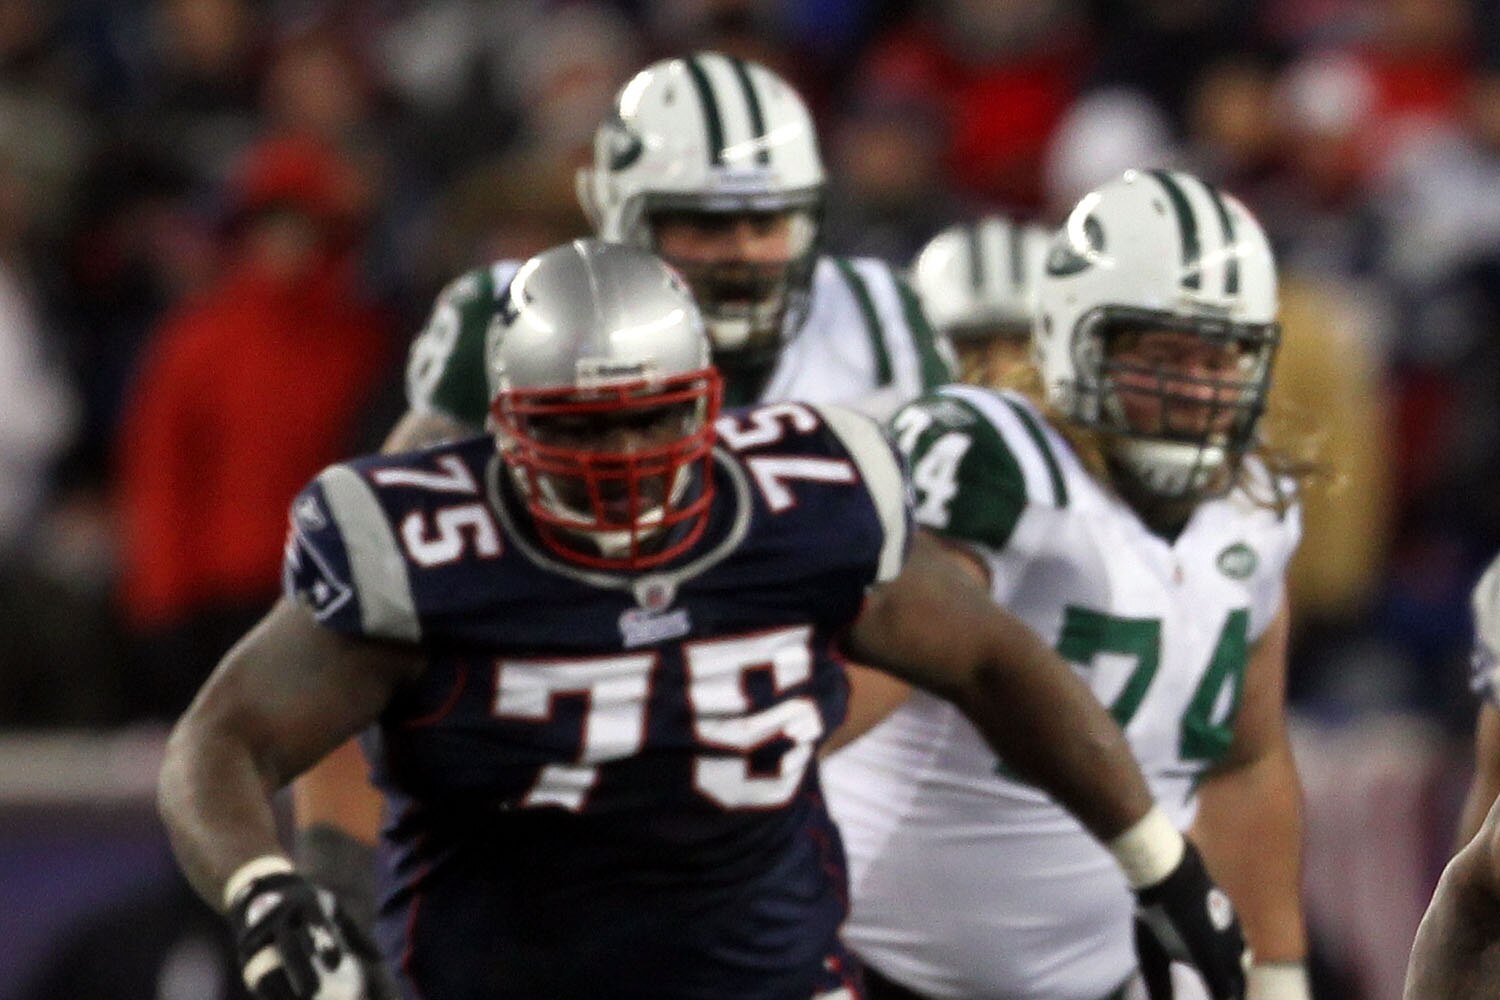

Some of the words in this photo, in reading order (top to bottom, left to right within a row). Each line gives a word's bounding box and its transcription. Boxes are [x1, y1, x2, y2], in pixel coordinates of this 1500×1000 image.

[373, 455, 501, 569] 75
[716, 402, 858, 514] 75
[893, 405, 972, 529] 74
[492, 624, 824, 813] 75
[1058, 605, 1252, 760] 74
